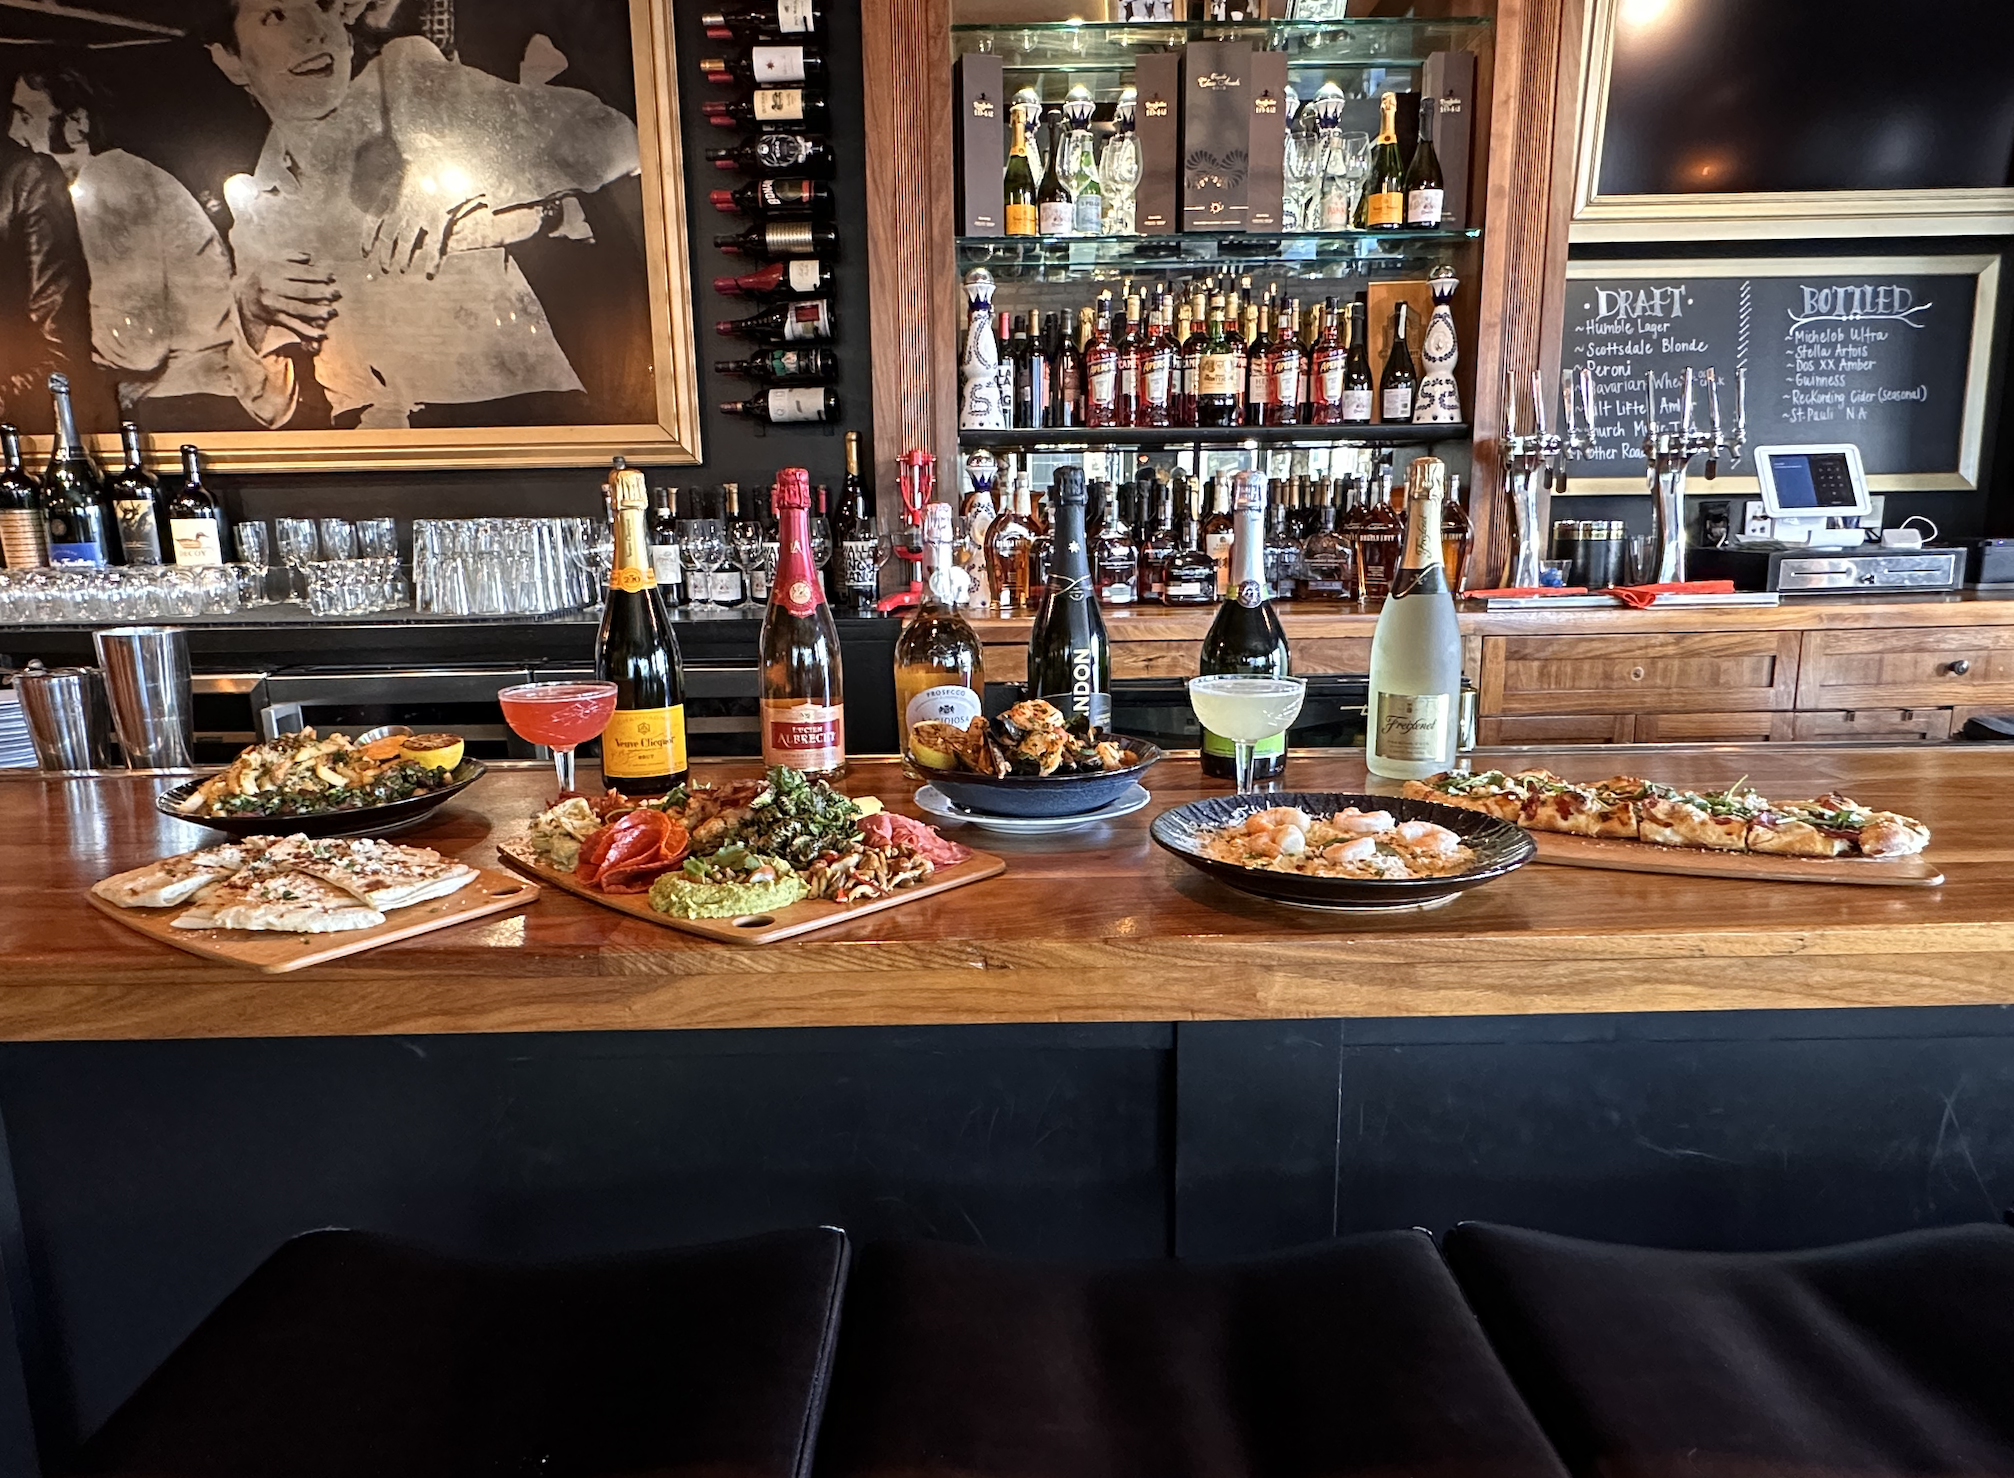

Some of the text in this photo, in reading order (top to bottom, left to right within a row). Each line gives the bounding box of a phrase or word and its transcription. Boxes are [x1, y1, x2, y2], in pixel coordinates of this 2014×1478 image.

[1595, 285, 1686, 320] DRAFT
[1800, 285, 1912, 317] BOTTLED
[1586, 319, 1671, 339] Humble Lager
[1795, 326, 1889, 344] Michelob Ultra
[1586, 337, 1709, 358] Scottsdale Blonde
[1795, 343, 1868, 359] Stella Artois
[1586, 360, 1631, 377] Peroni
[1796, 359, 1877, 372] Dos XX Amber
[1593, 374, 1646, 396] avarian
[1795, 373, 1846, 387] Guinness
[1850, 389, 1876, 404] Cider
[1593, 400, 1612, 417] ilt
[1616, 400, 1647, 416] Lifte
[1592, 421, 1626, 438] hurch
[926, 689, 966, 698] PROSECCO
[1381, 715, 1437, 735] Freixenet
[615, 736, 675, 748] Veuve Clicquot
[777, 732, 836, 748] ALBRECHT
